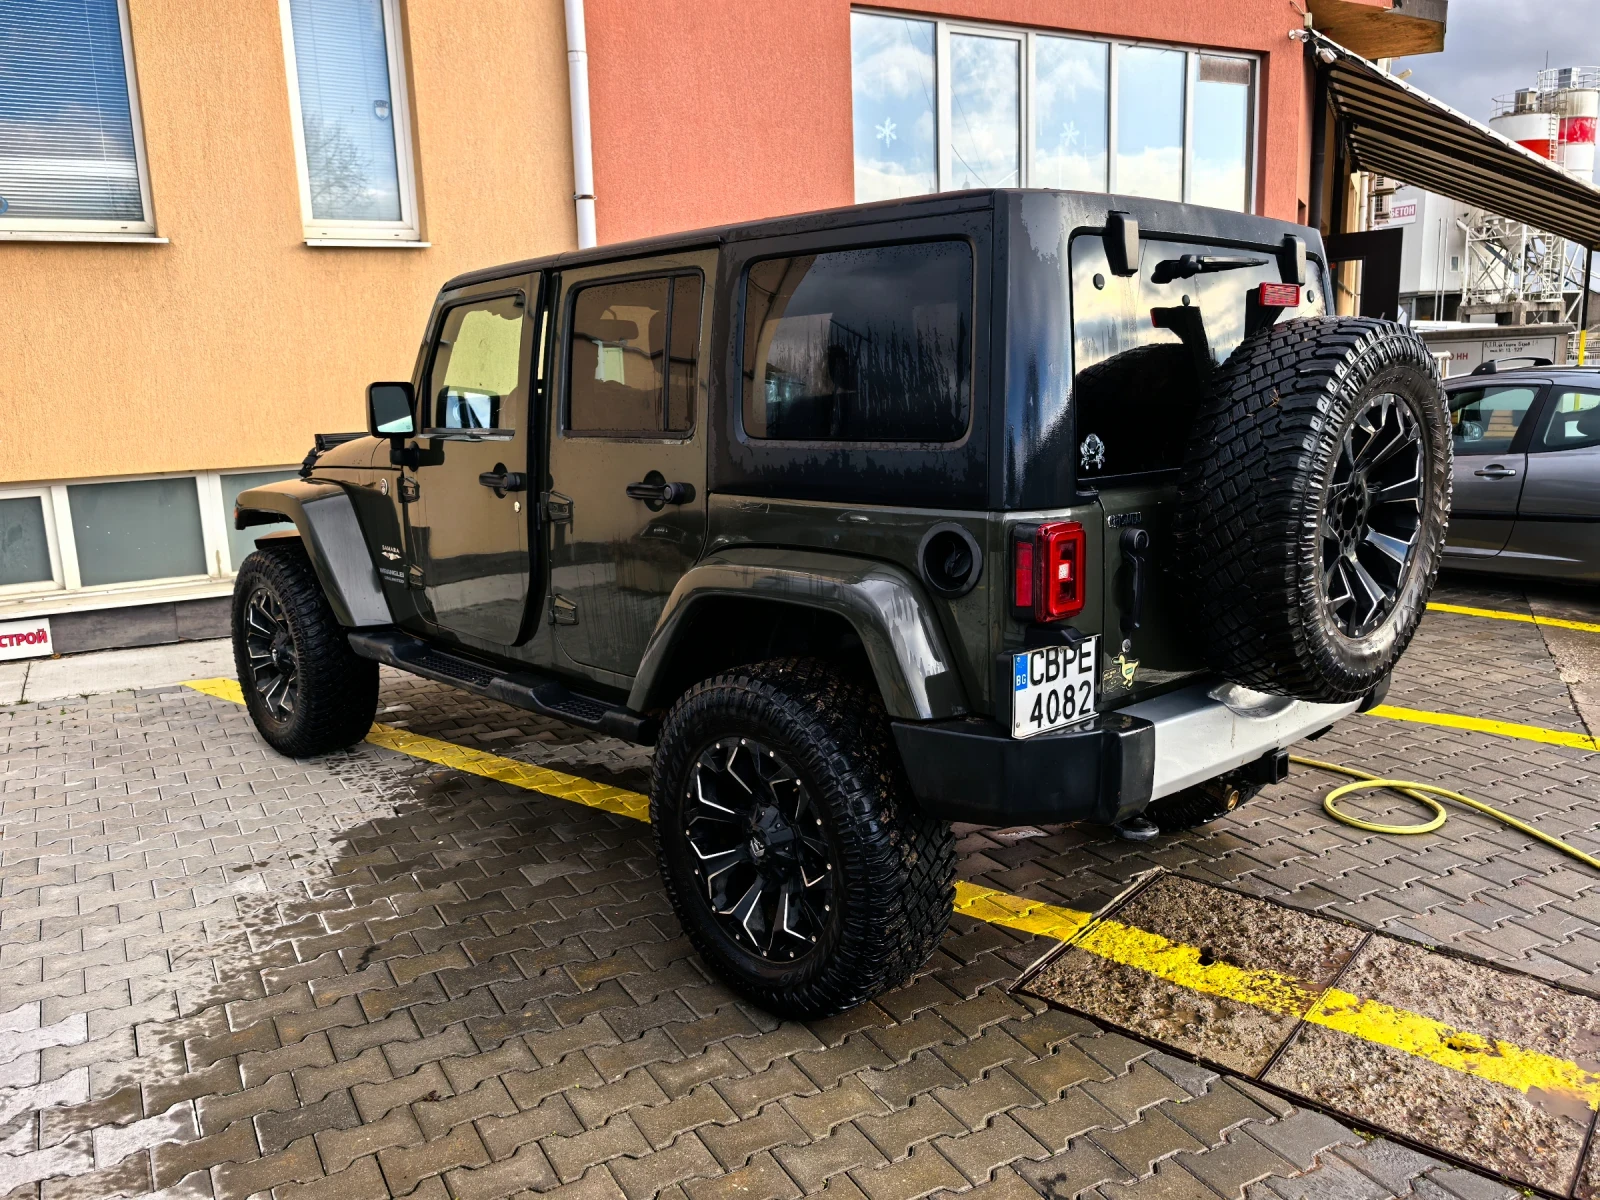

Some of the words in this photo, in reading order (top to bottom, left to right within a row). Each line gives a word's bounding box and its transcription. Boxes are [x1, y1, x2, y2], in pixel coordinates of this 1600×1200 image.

[0, 628, 48, 648] СТРОЙ
[1030, 638, 1092, 686] CBPE
[1016, 674, 1027, 686] BG
[1030, 680, 1092, 728] 4082
